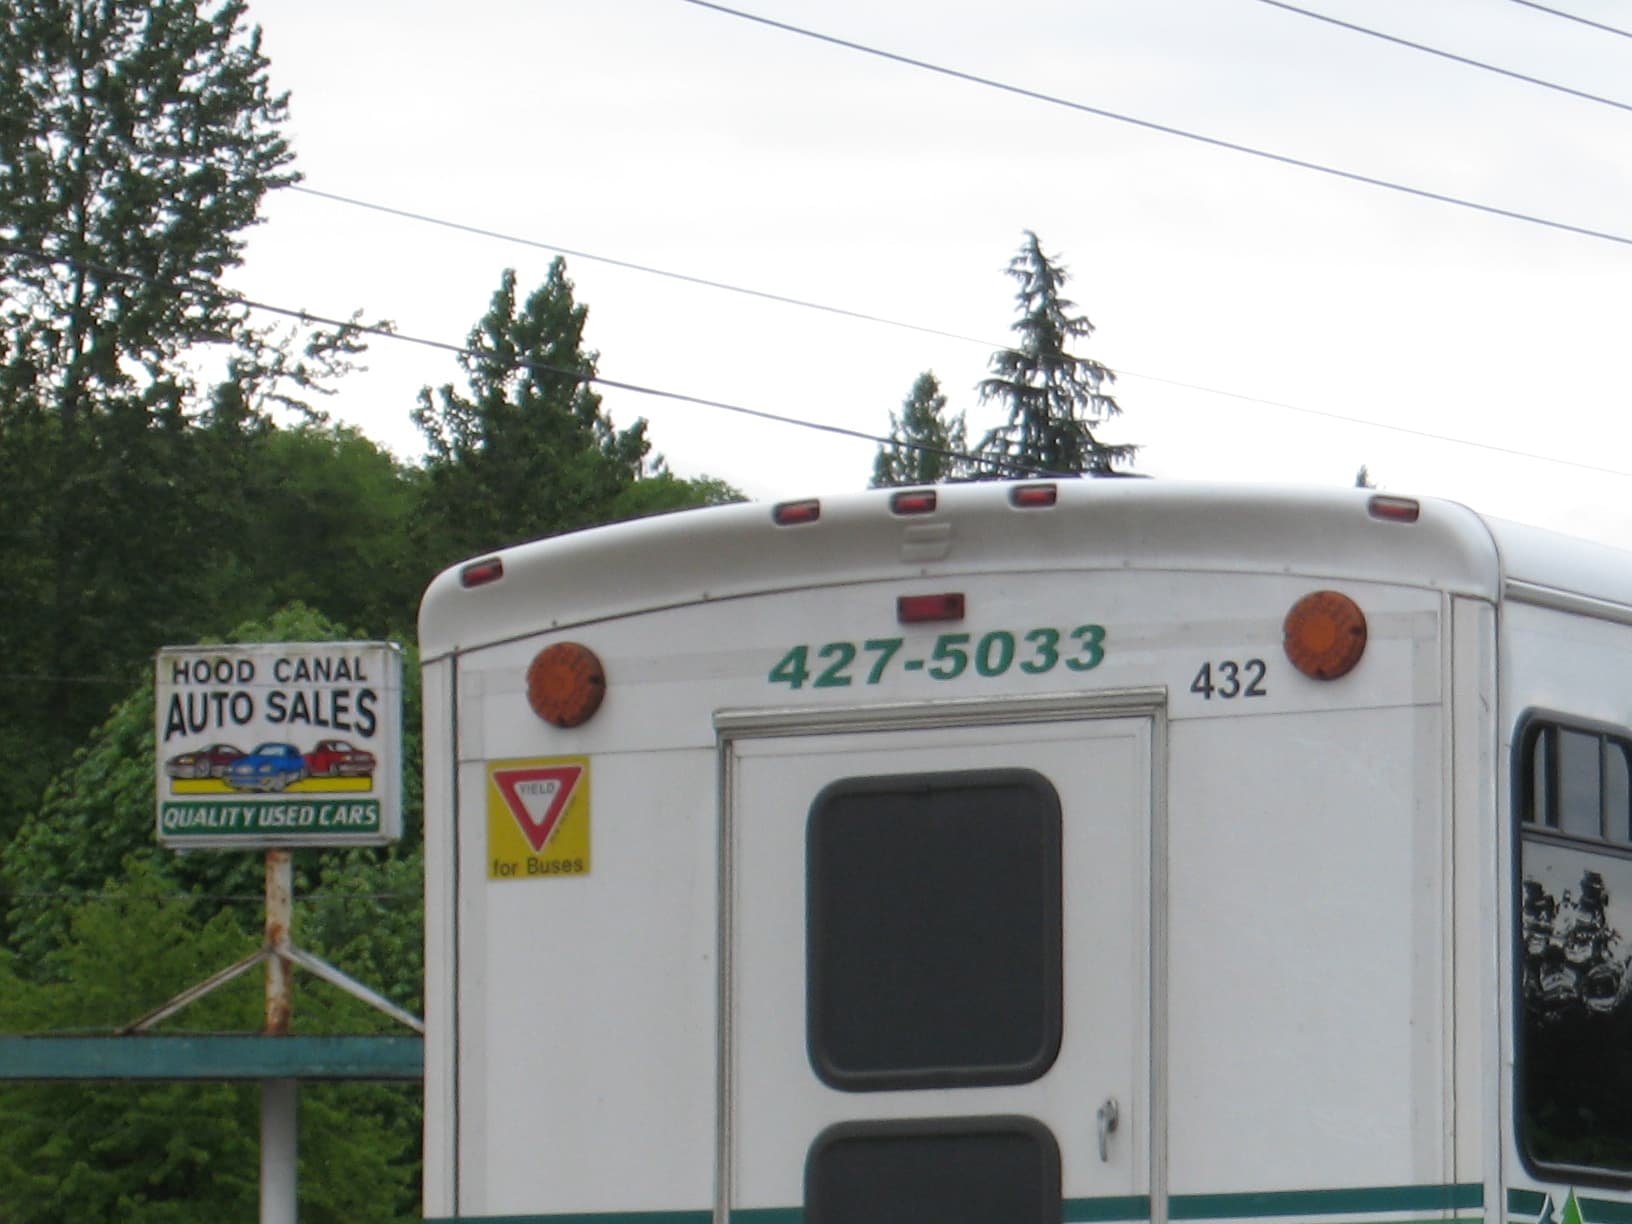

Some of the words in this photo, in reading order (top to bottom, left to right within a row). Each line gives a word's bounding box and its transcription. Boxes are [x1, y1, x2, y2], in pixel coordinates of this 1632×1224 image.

[768, 624, 1107, 688] 427-5033
[172, 659, 255, 684] HOOD
[273, 657, 368, 683] CANAL
[1189, 658, 1268, 700] 432
[164, 691, 254, 742] AUTO
[265, 688, 378, 737] SALES
[519, 782, 556, 795] YIELD
[164, 806, 256, 829] QUALITY
[258, 806, 314, 827] USED
[319, 804, 377, 825] CARS
[494, 858, 518, 877] for
[527, 857, 584, 875] Buses
